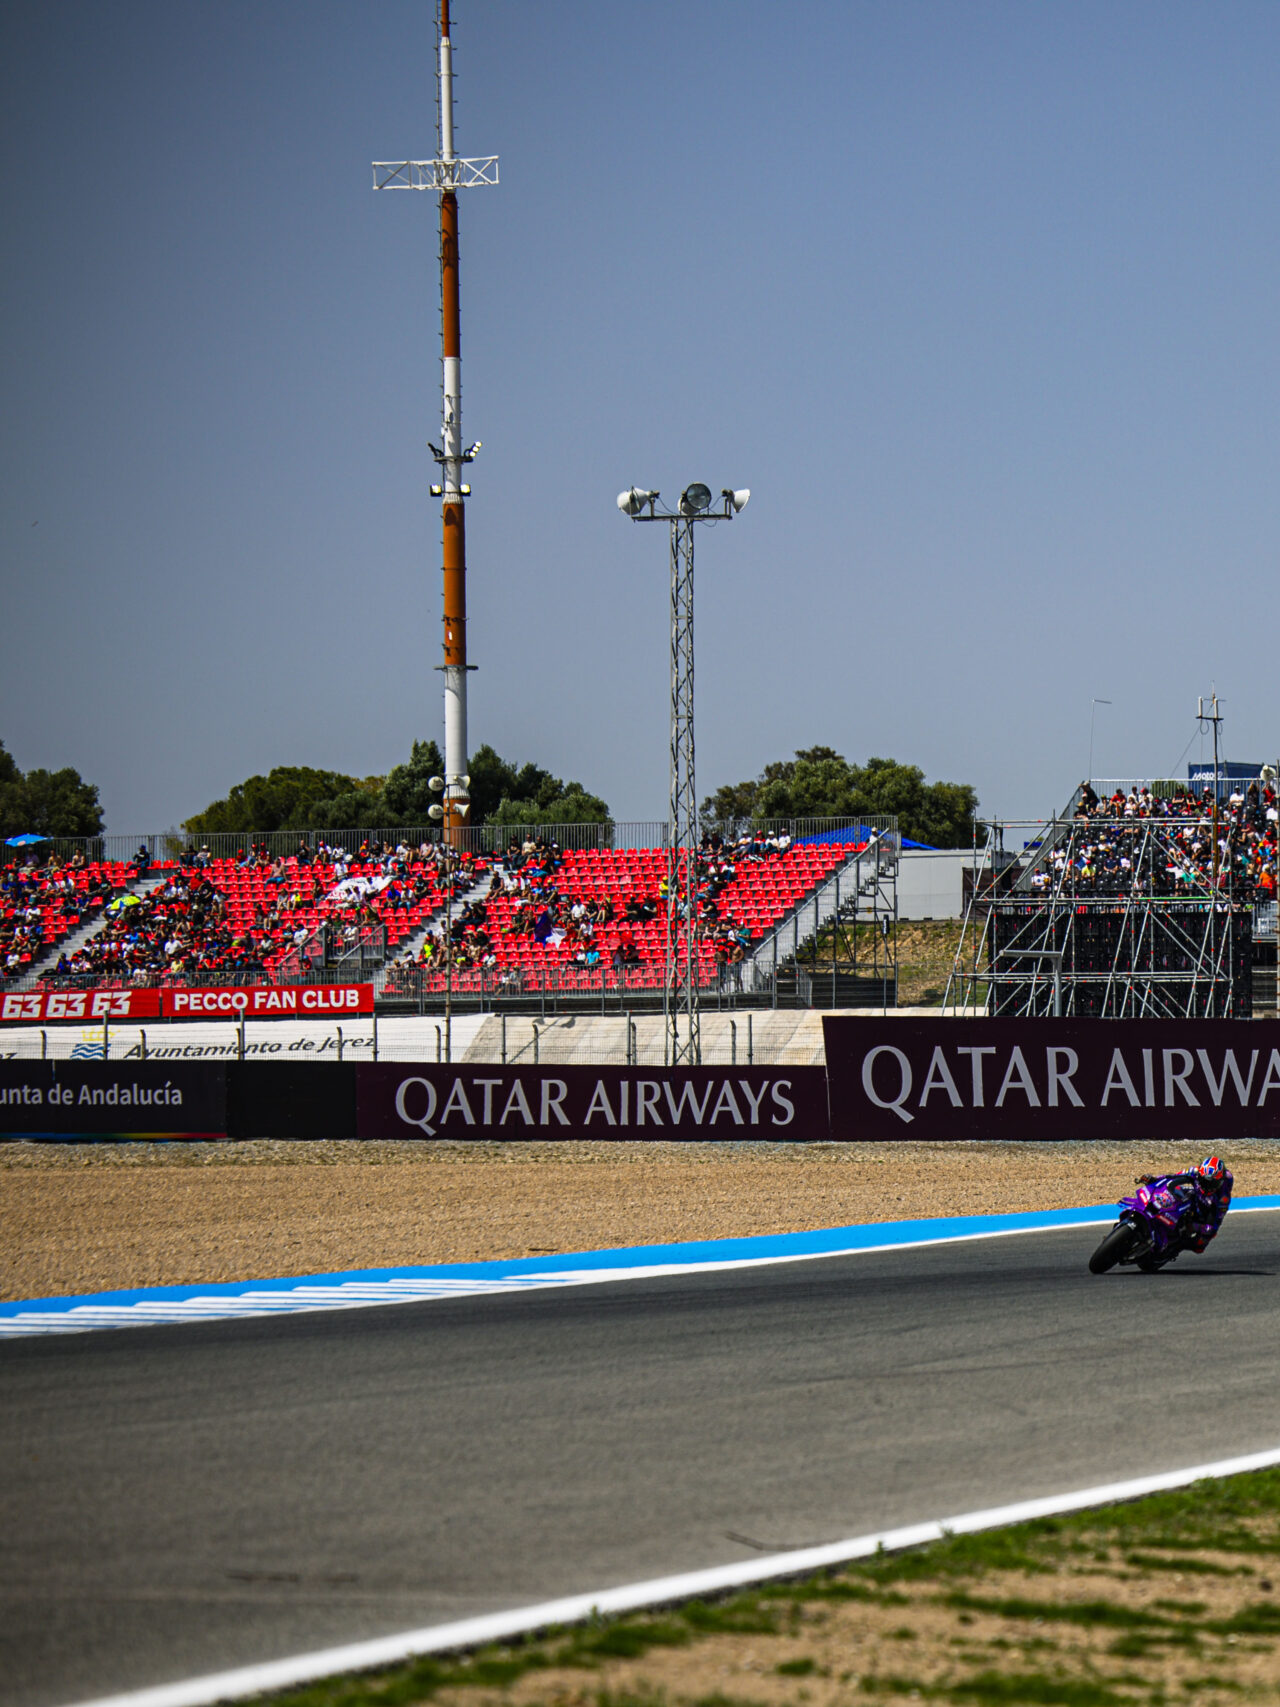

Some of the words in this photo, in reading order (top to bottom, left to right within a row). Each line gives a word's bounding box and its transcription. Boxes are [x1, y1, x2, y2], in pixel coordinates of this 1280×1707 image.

[2, 995, 43, 1018] 63
[46, 993, 87, 1017] 63
[91, 991, 132, 1016] 63
[174, 992, 248, 1011] PECCO
[254, 991, 296, 1009] FAN
[302, 990, 359, 1008] CLUB
[288, 1038, 315, 1051] de
[48, 1083, 74, 1105] de
[78, 1081, 183, 1105] Andalucía
[862, 1045, 1086, 1124] QATAR
[394, 1076, 572, 1137] QATAR
[583, 1079, 795, 1126] AIRWAYS
